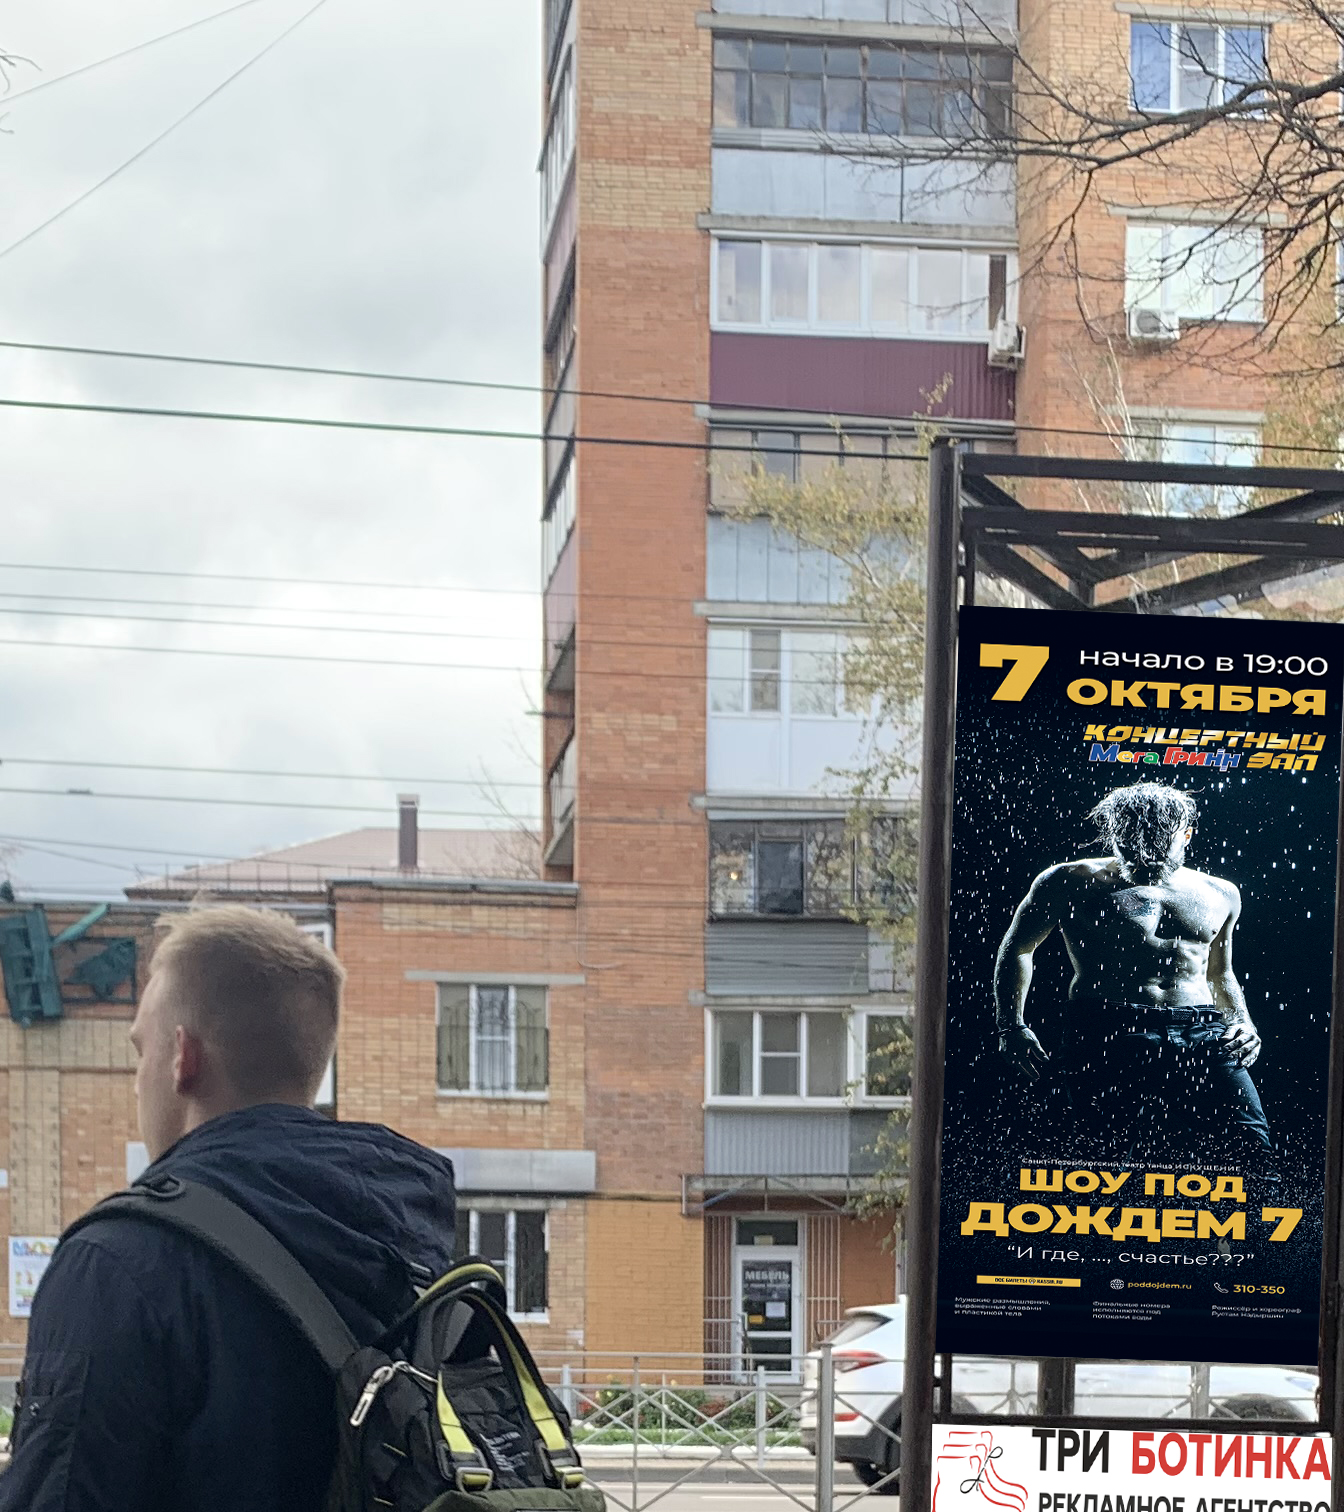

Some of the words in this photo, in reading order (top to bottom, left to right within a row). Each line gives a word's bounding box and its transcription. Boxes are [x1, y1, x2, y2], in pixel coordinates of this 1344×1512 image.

[979, 643, 1049, 702] 7
[1080, 650, 1205, 671] начало
[1216, 656, 1234, 672] в
[1243, 653, 1328, 676] 19:00
[1066, 678, 1327, 716] ОКТЯБРЯ
[1083, 724, 1327, 751] КОНЦЕРТНЫЙ
[1088, 743, 1159, 764] Мега
[1246, 752, 1319, 771] ЗАЛ
[1019, 1168, 1132, 1194] ШОУ
[1144, 1172, 1247, 1203] ПОД
[960, 1202, 1247, 1243] ДОЖДЕМ
[1261, 1206, 1303, 1242] 7
[1042, 1249, 1085, 1263] где,
[1127, 1282, 1192, 1290] poddojdem.ru
[1233, 1284, 1285, 1295] 310-350
[1032, 1429, 1110, 1473] ТРИ
[1131, 1432, 1332, 1480] БОТИНКА
